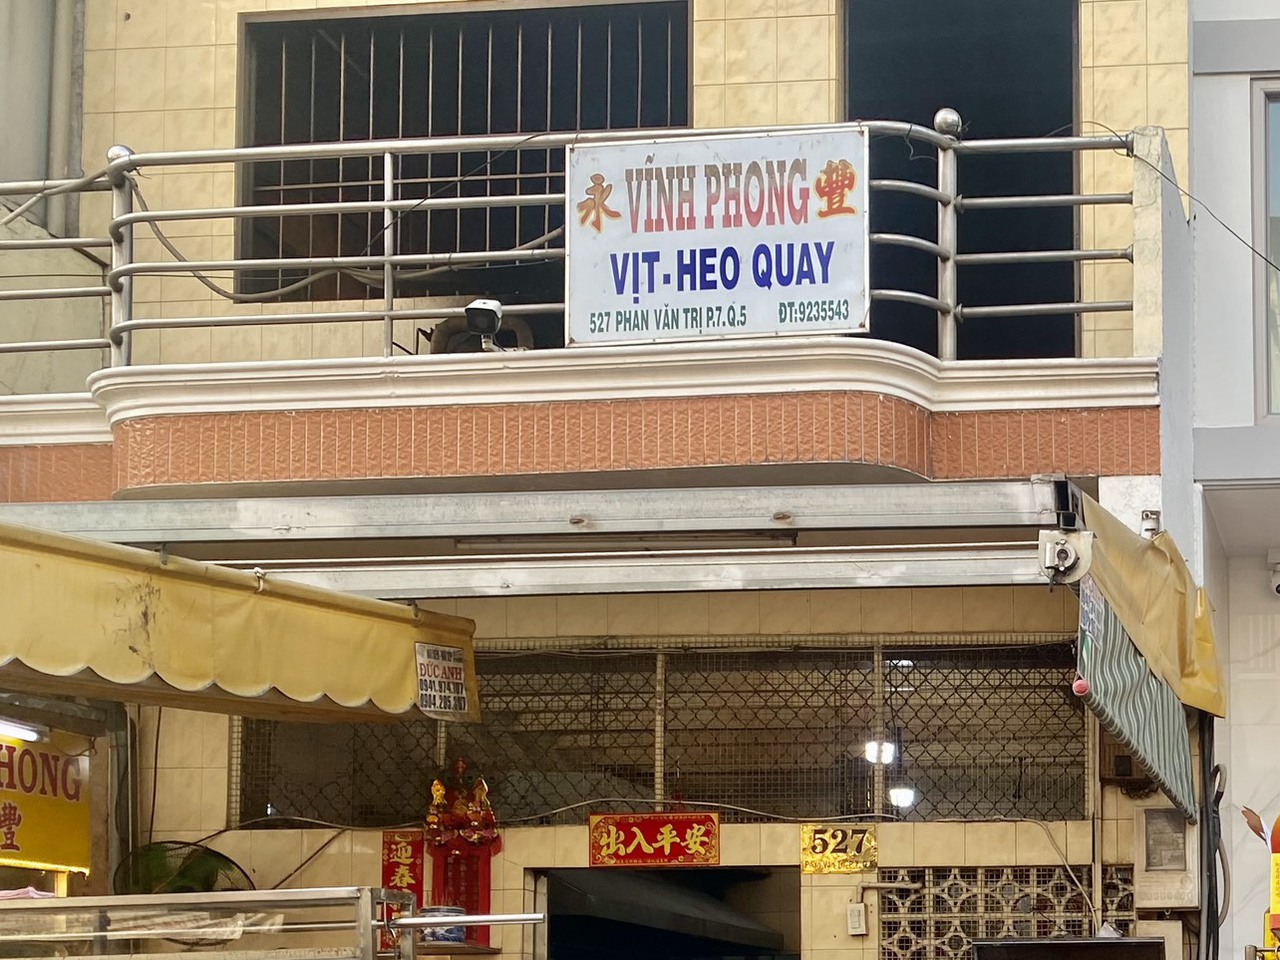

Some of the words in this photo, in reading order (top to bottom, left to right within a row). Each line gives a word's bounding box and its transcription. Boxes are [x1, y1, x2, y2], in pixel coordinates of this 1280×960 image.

[577, 172, 622, 234] 永
[625, 153, 697, 234] VĨNH
[703, 158, 811, 231] PHONG
[752, 240, 836, 291] QUAY
[589, 311, 611, 334] 527
[615, 308, 650, 333] PHAN
[654, 303, 680, 331] VĂN
[683, 306, 703, 335] TRỊ
[418, 660, 440, 679] ĐỨC
[440, 665, 463, 681] ANH
[599, 823, 710, 857] 出入平安
[811, 828, 868, 855] 527
